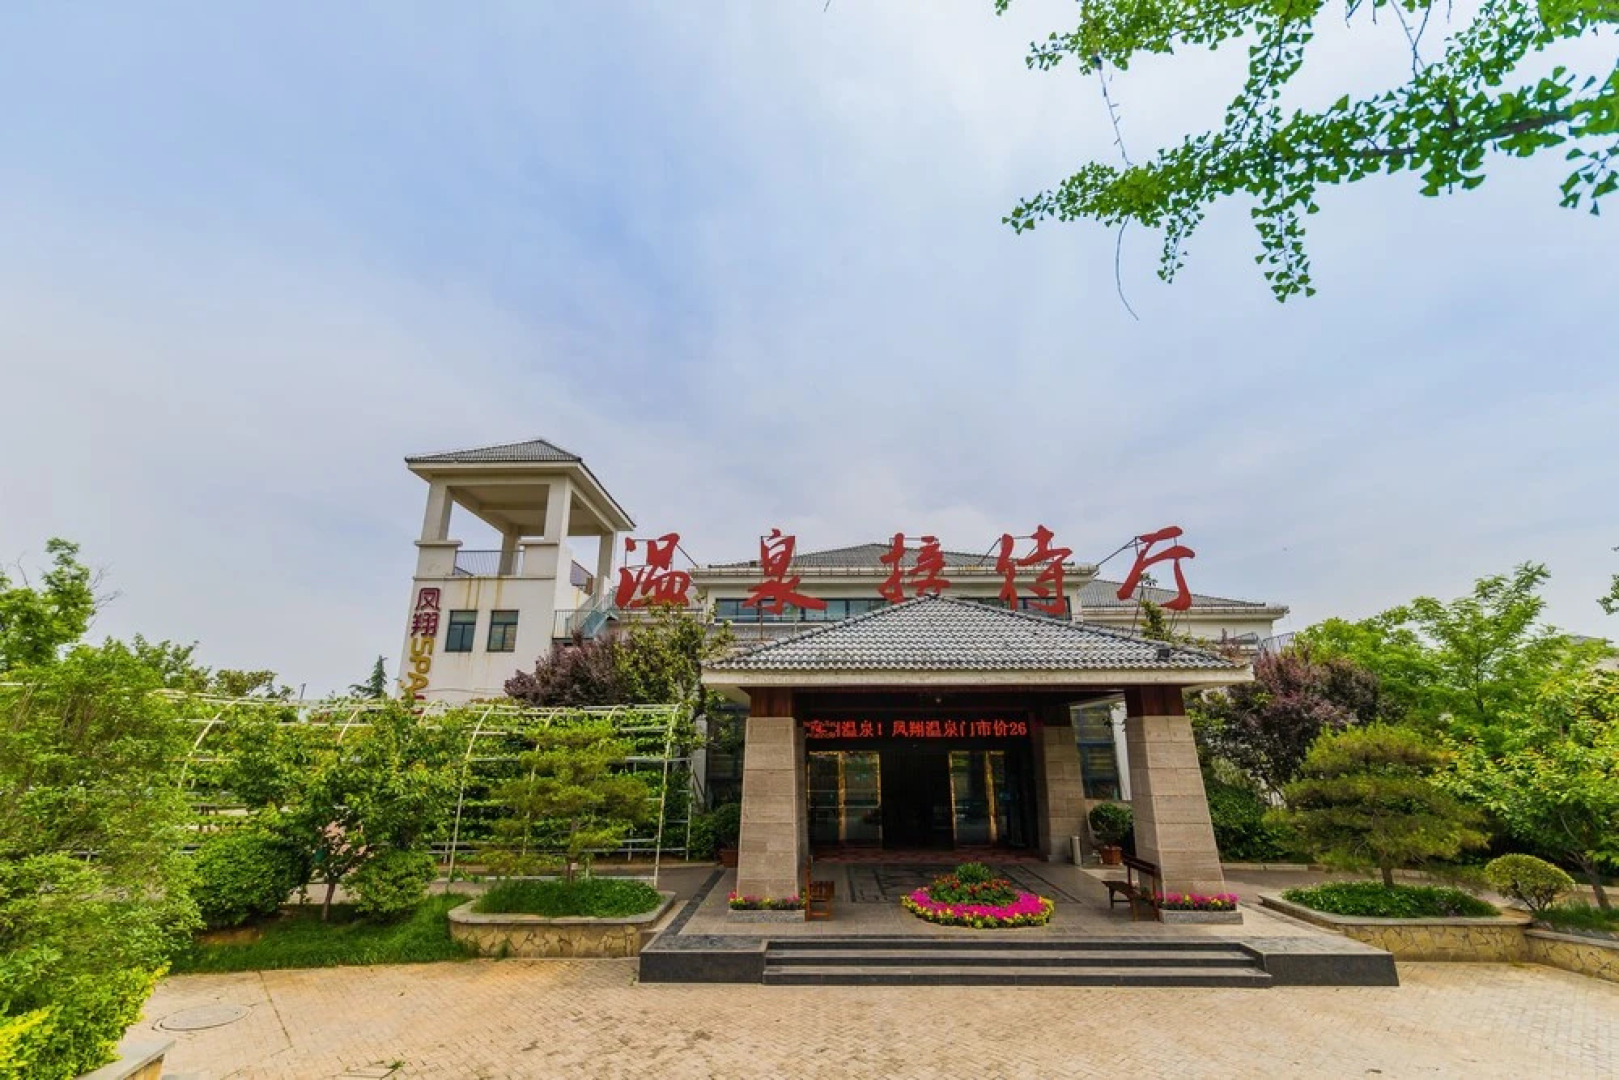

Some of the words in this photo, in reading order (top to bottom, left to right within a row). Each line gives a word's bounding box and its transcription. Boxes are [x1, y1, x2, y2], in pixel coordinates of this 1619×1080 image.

[616, 525, 1196, 616] 温泉接待厅
